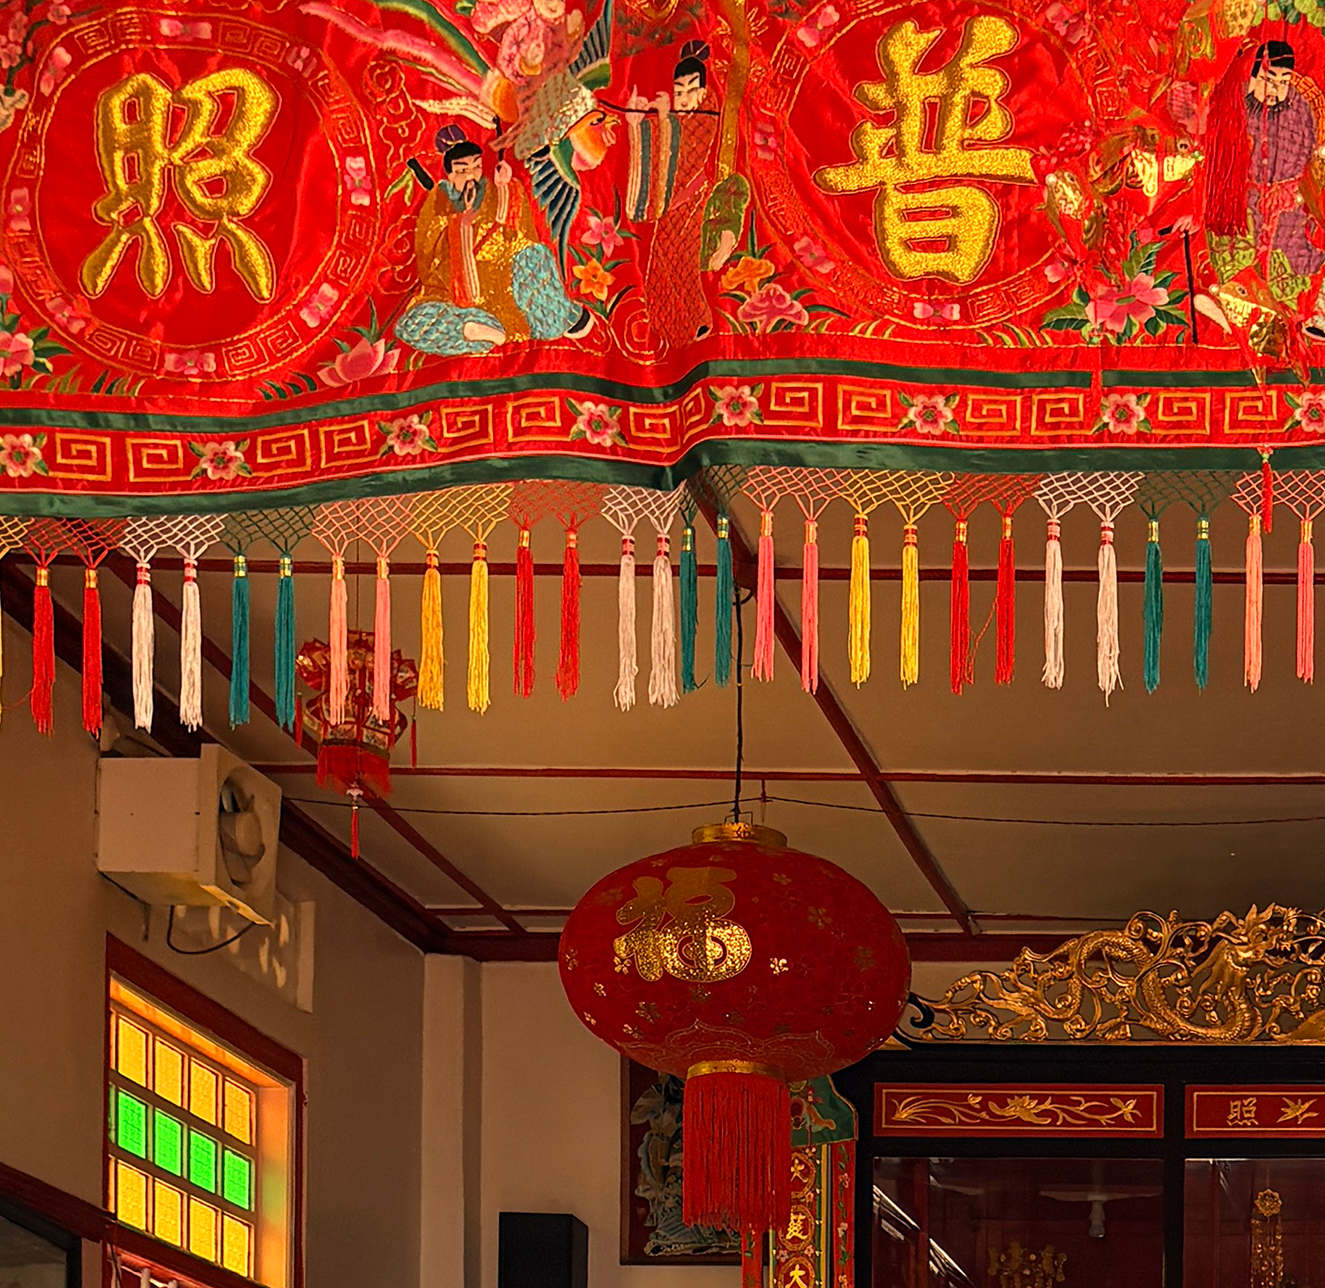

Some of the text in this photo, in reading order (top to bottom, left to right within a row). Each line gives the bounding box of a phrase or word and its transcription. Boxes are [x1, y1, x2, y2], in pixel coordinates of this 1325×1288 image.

[81, 67, 278, 304] 照
[815, 13, 1038, 285] 普
[613, 866, 753, 982] 福
